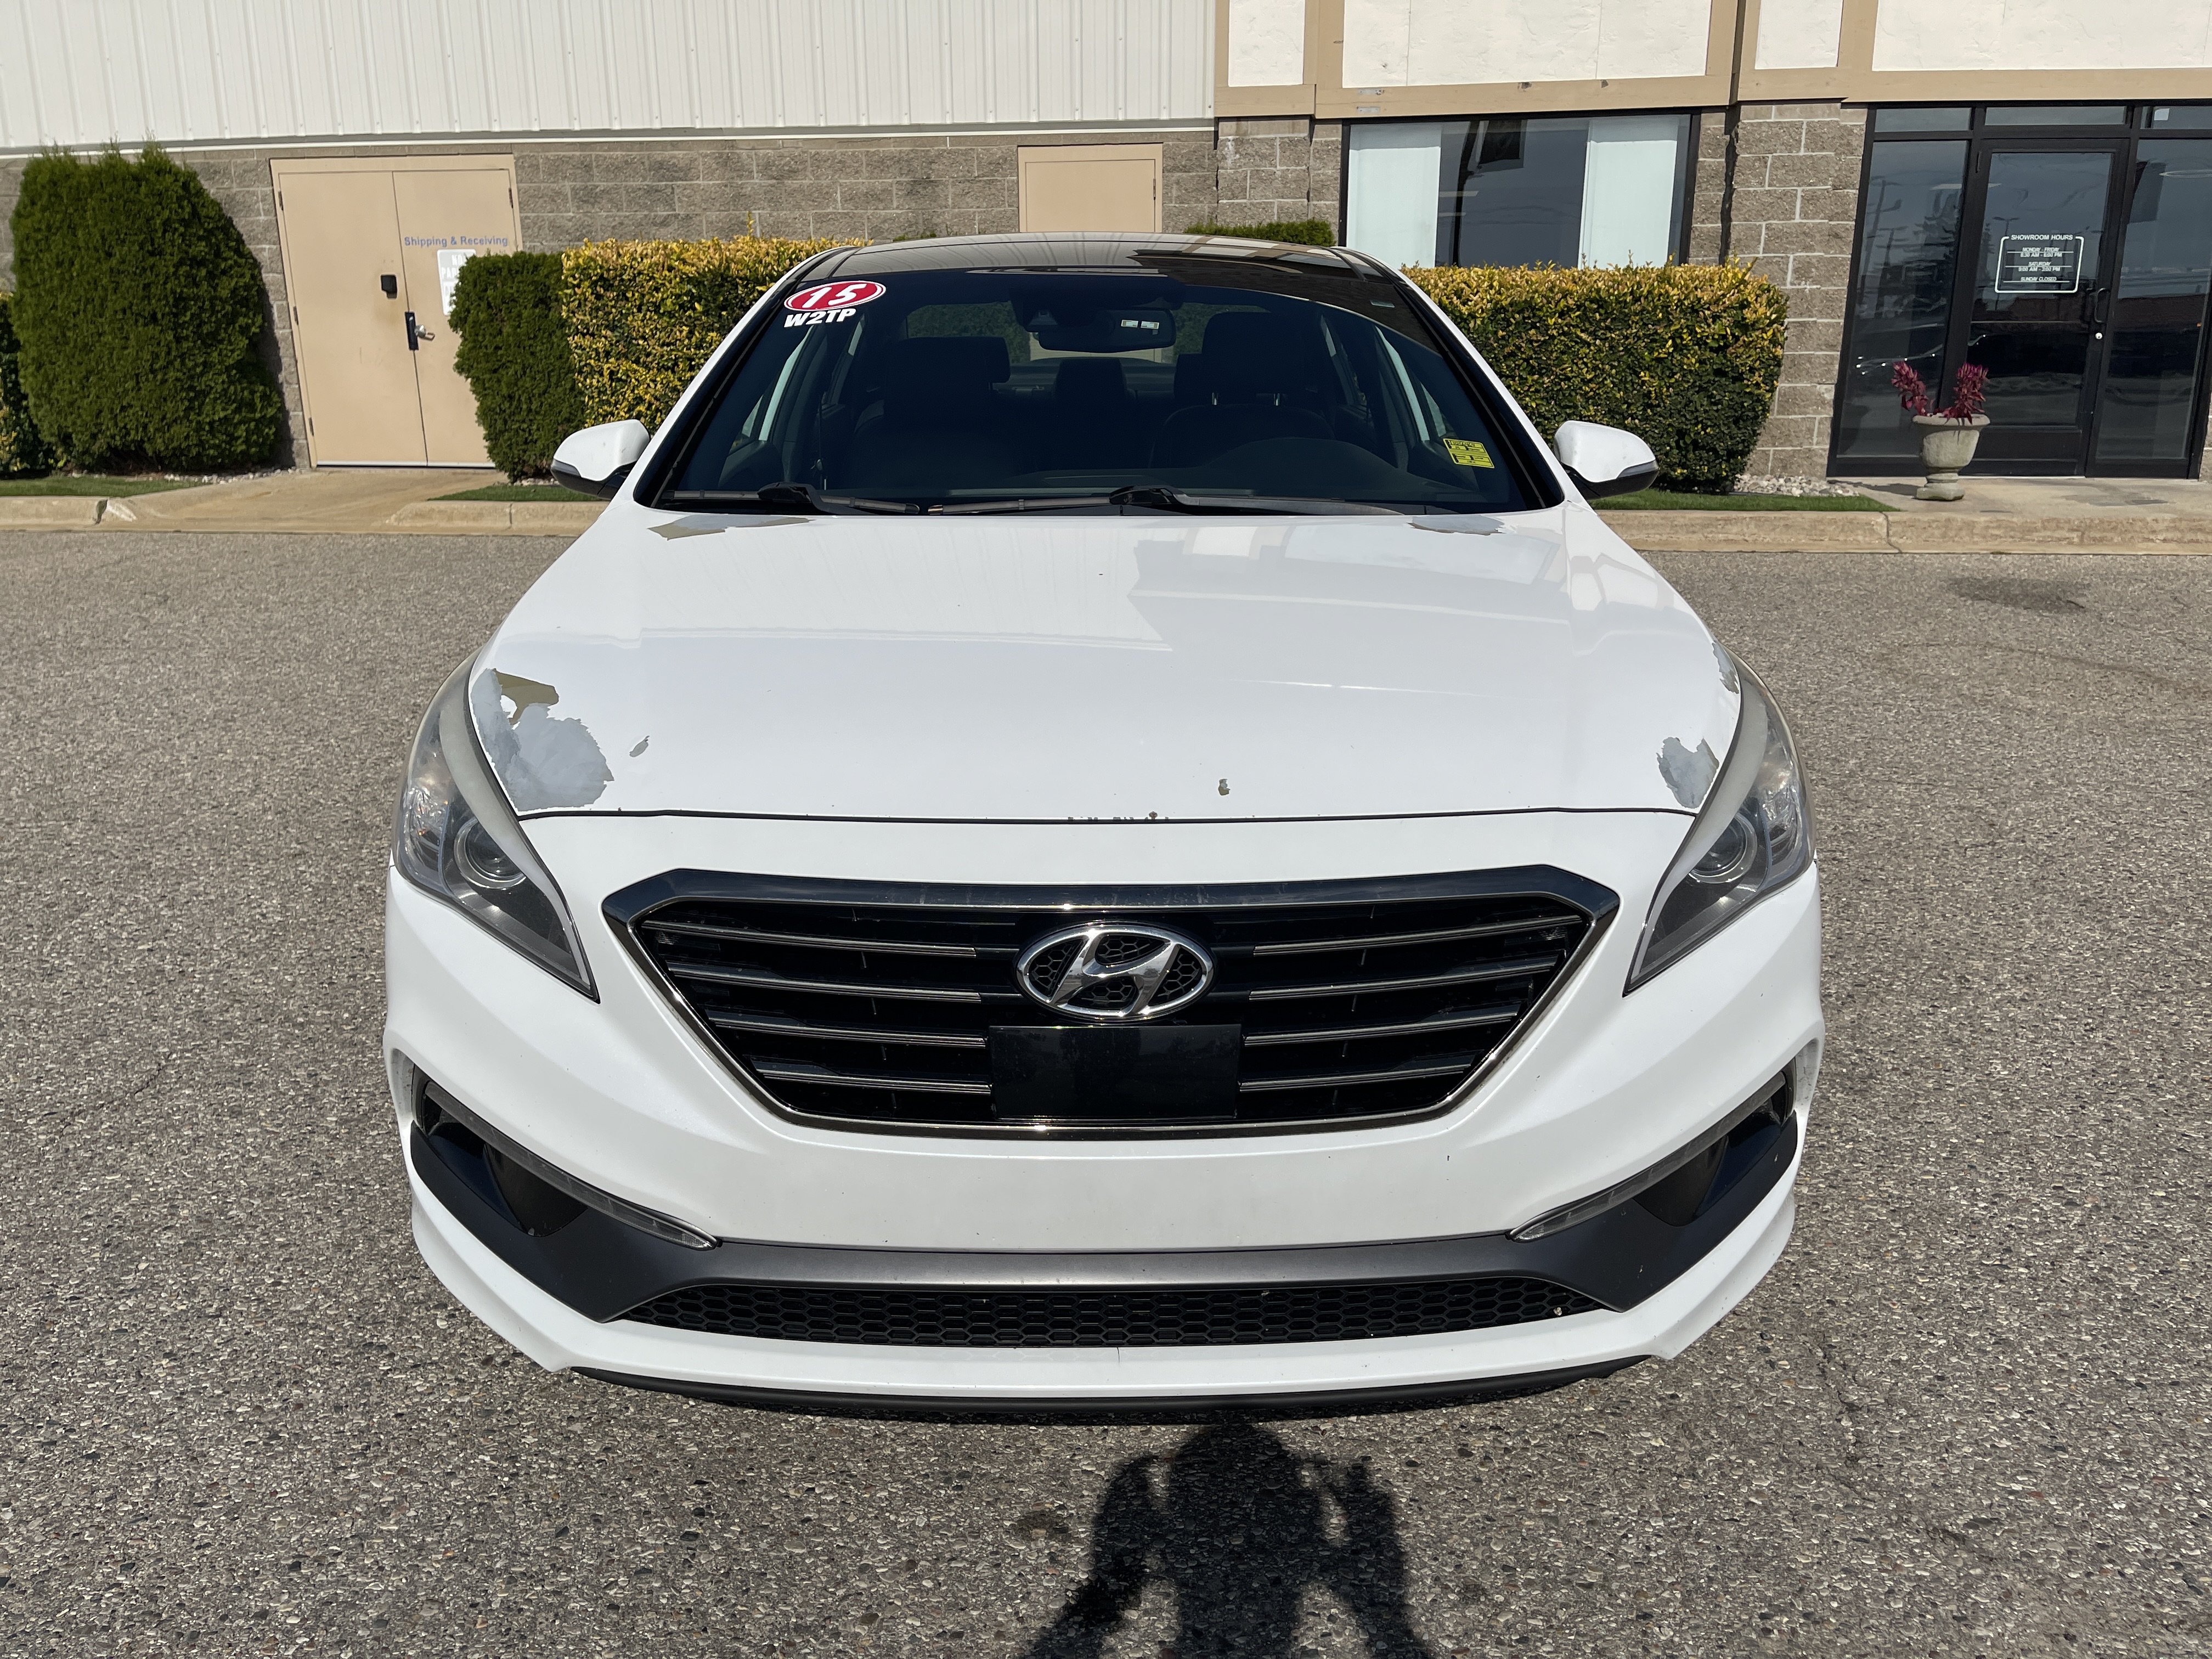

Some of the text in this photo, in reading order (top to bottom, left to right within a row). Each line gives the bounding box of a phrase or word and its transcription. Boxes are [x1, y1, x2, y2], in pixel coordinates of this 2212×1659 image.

[404, 236, 508, 247] Shipping & Receiving
[452, 254, 464, 266] NO
[802, 283, 867, 308] 15
[784, 308, 856, 328] W2TP
